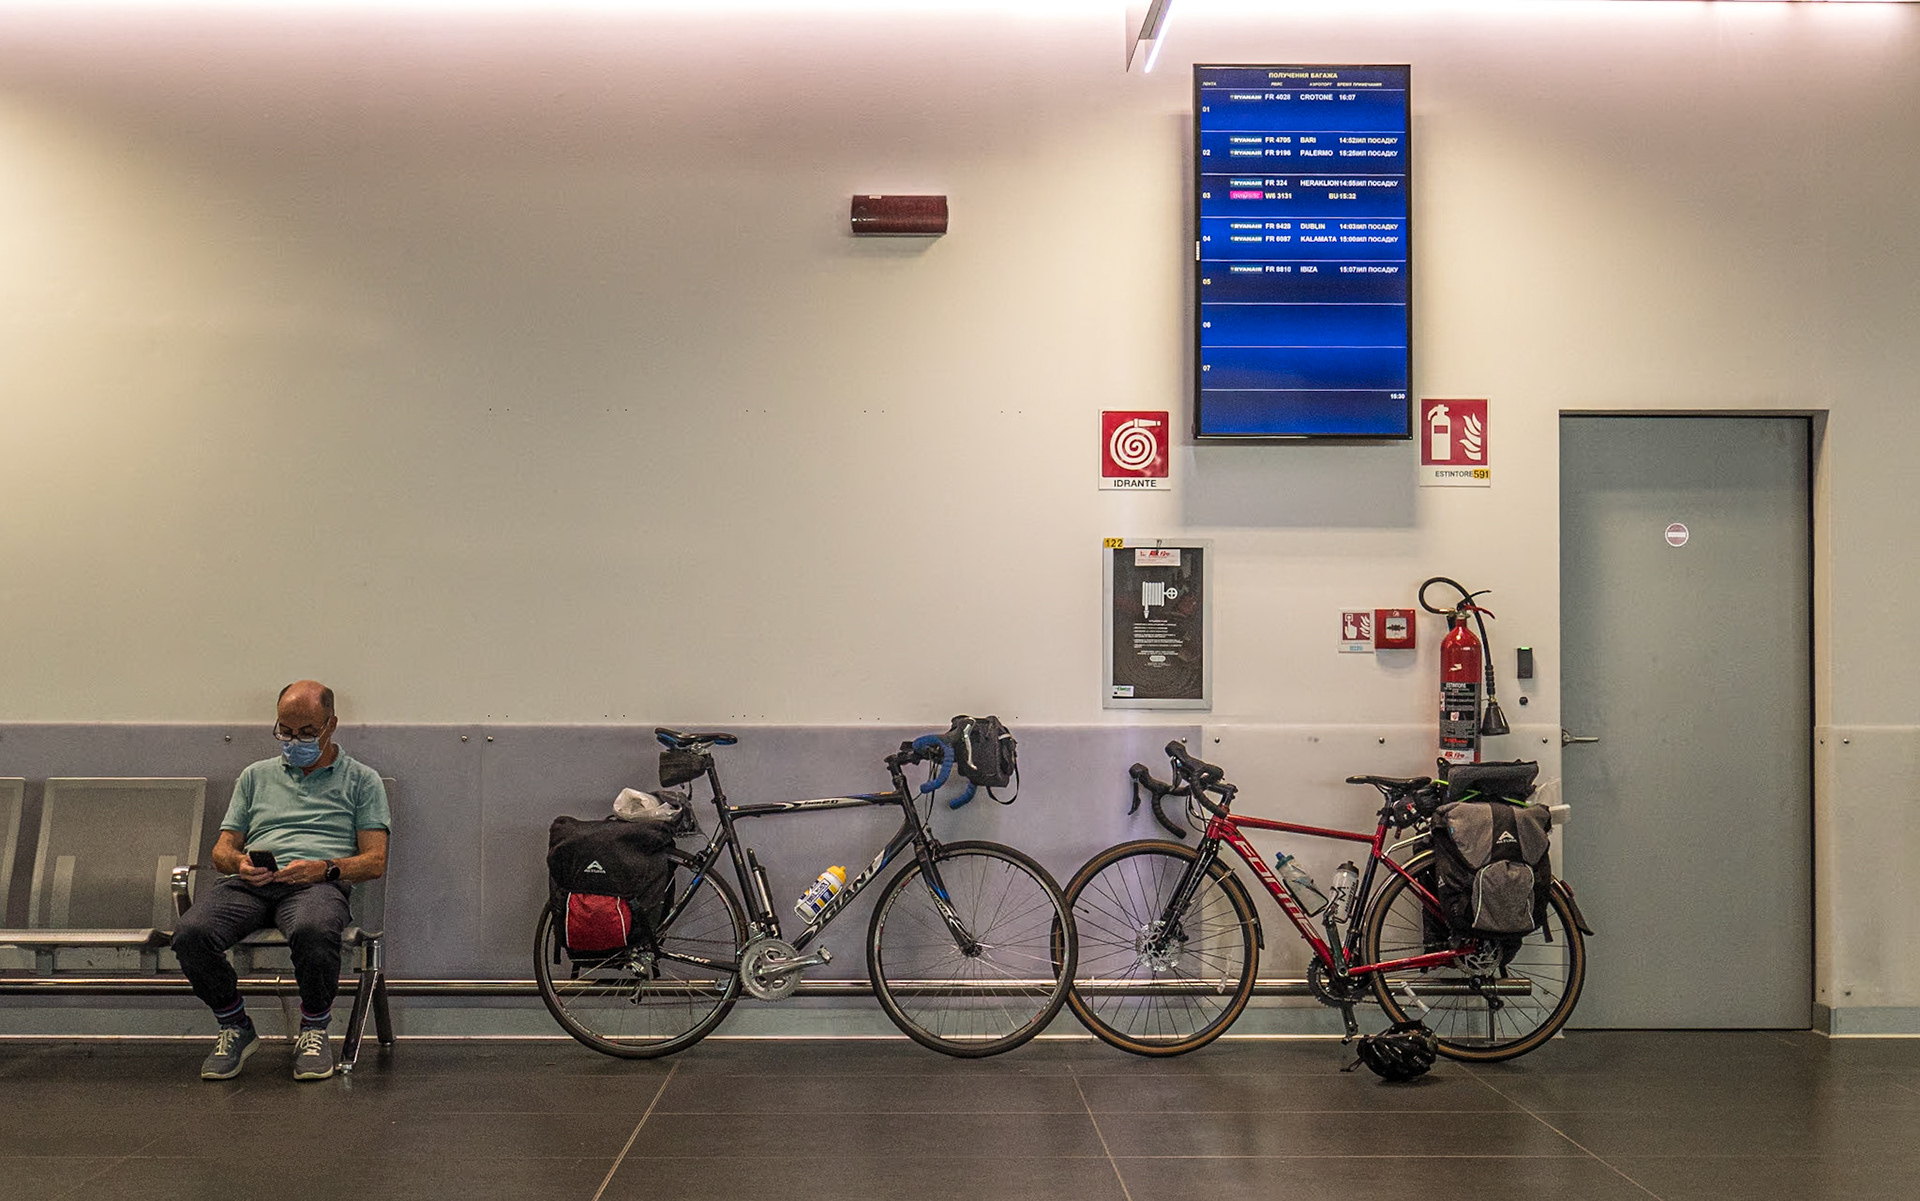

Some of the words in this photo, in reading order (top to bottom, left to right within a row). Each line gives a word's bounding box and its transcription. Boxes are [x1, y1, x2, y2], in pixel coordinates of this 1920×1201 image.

[1264, 93, 1275, 101] FR
[1299, 93, 1334, 101] CROTONE
[1264, 136, 1275, 144] FR
[1299, 136, 1318, 144] BARI
[1264, 149, 1275, 157] FR
[1299, 149, 1334, 157] PALERMO
[1264, 179, 1275, 187] FR
[1299, 179, 1340, 187] HERAKLION
[1264, 222, 1275, 230] FR
[1299, 222, 1326, 230] DUBLIN
[1264, 235, 1275, 243] FR
[1299, 235, 1338, 243] KALAMATA
[1264, 265, 1275, 273] FR
[1299, 265, 1319, 273] IBIZA
[1435, 470, 1473, 478] ESTINTORE
[1473, 470, 1489, 478] 591
[1113, 479, 1157, 488] IDRANTE
[1105, 539, 1123, 548] 122
[820, 858, 875, 922] GIANT
